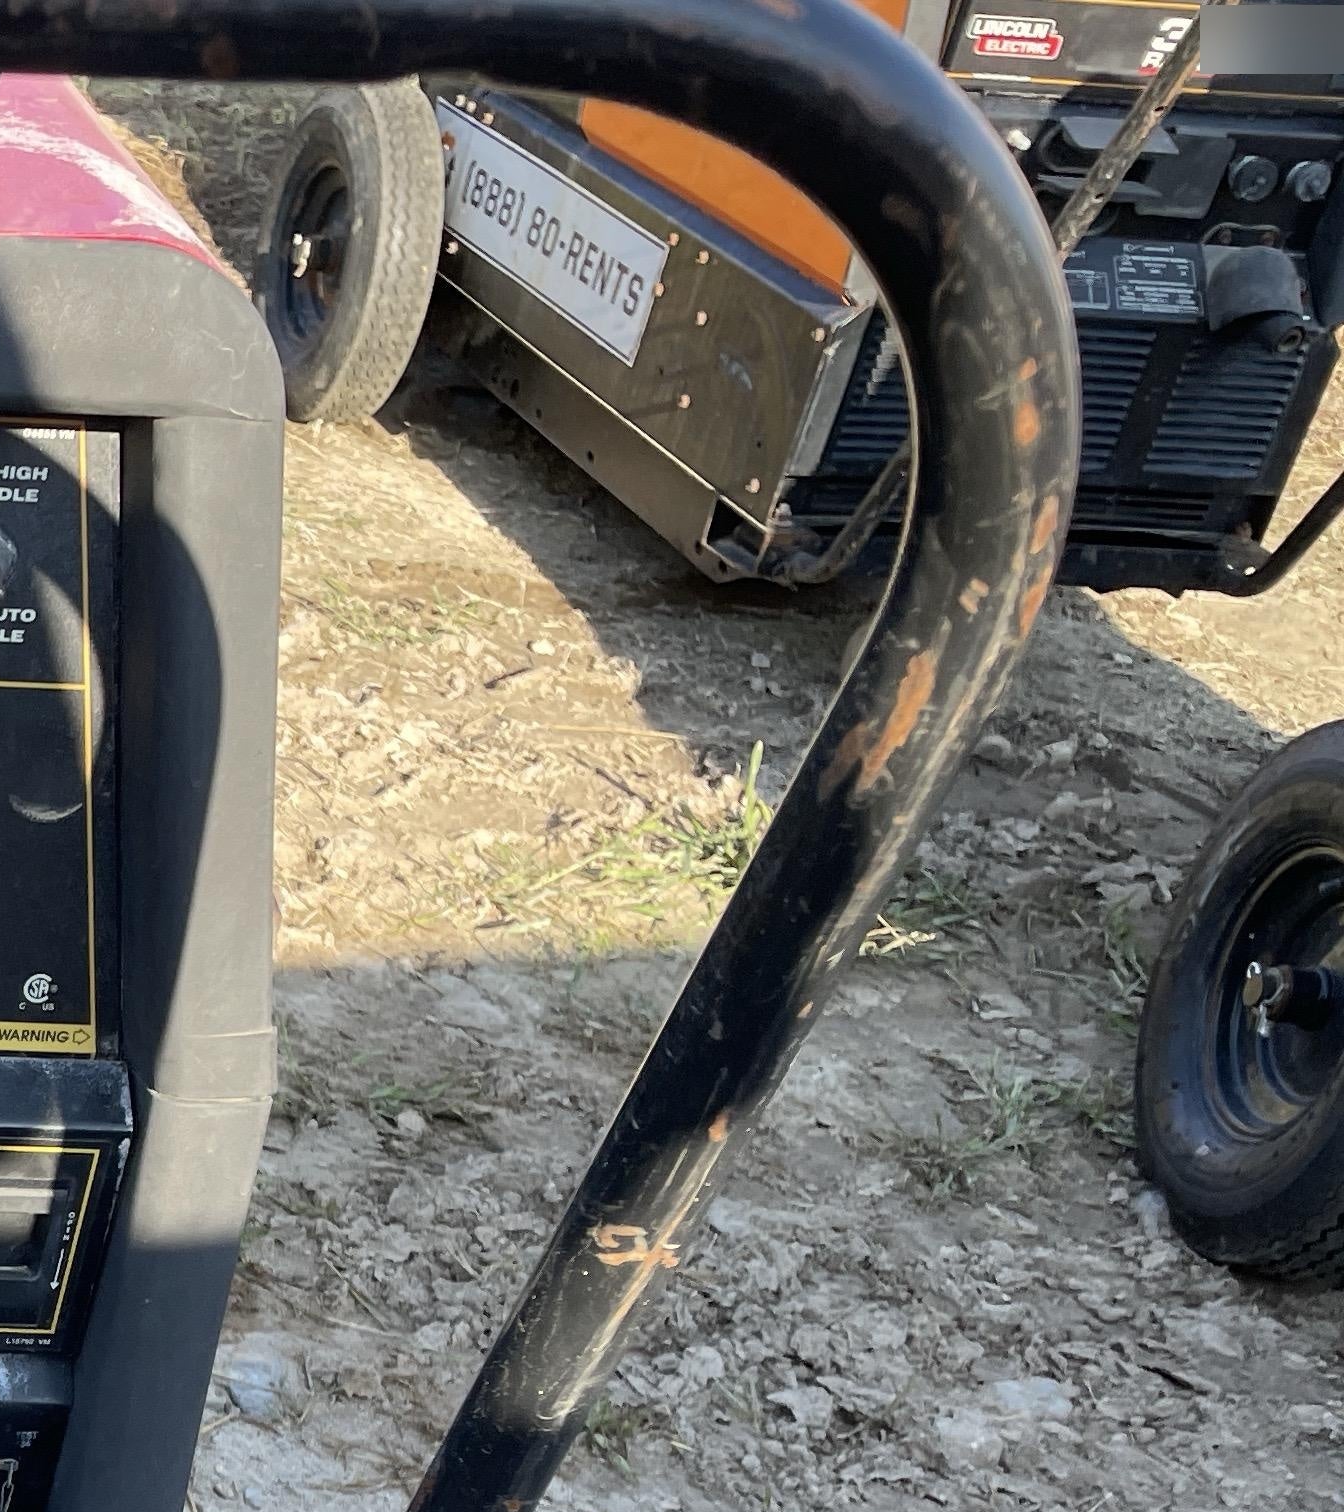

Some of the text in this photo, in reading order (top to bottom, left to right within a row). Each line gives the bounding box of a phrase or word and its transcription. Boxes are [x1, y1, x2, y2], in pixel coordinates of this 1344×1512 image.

[974, 19, 1050, 39] LINCOLN
[985, 41, 1050, 55] ELECTRIC
[463, 160, 644, 317] (888) 80-RENTS
